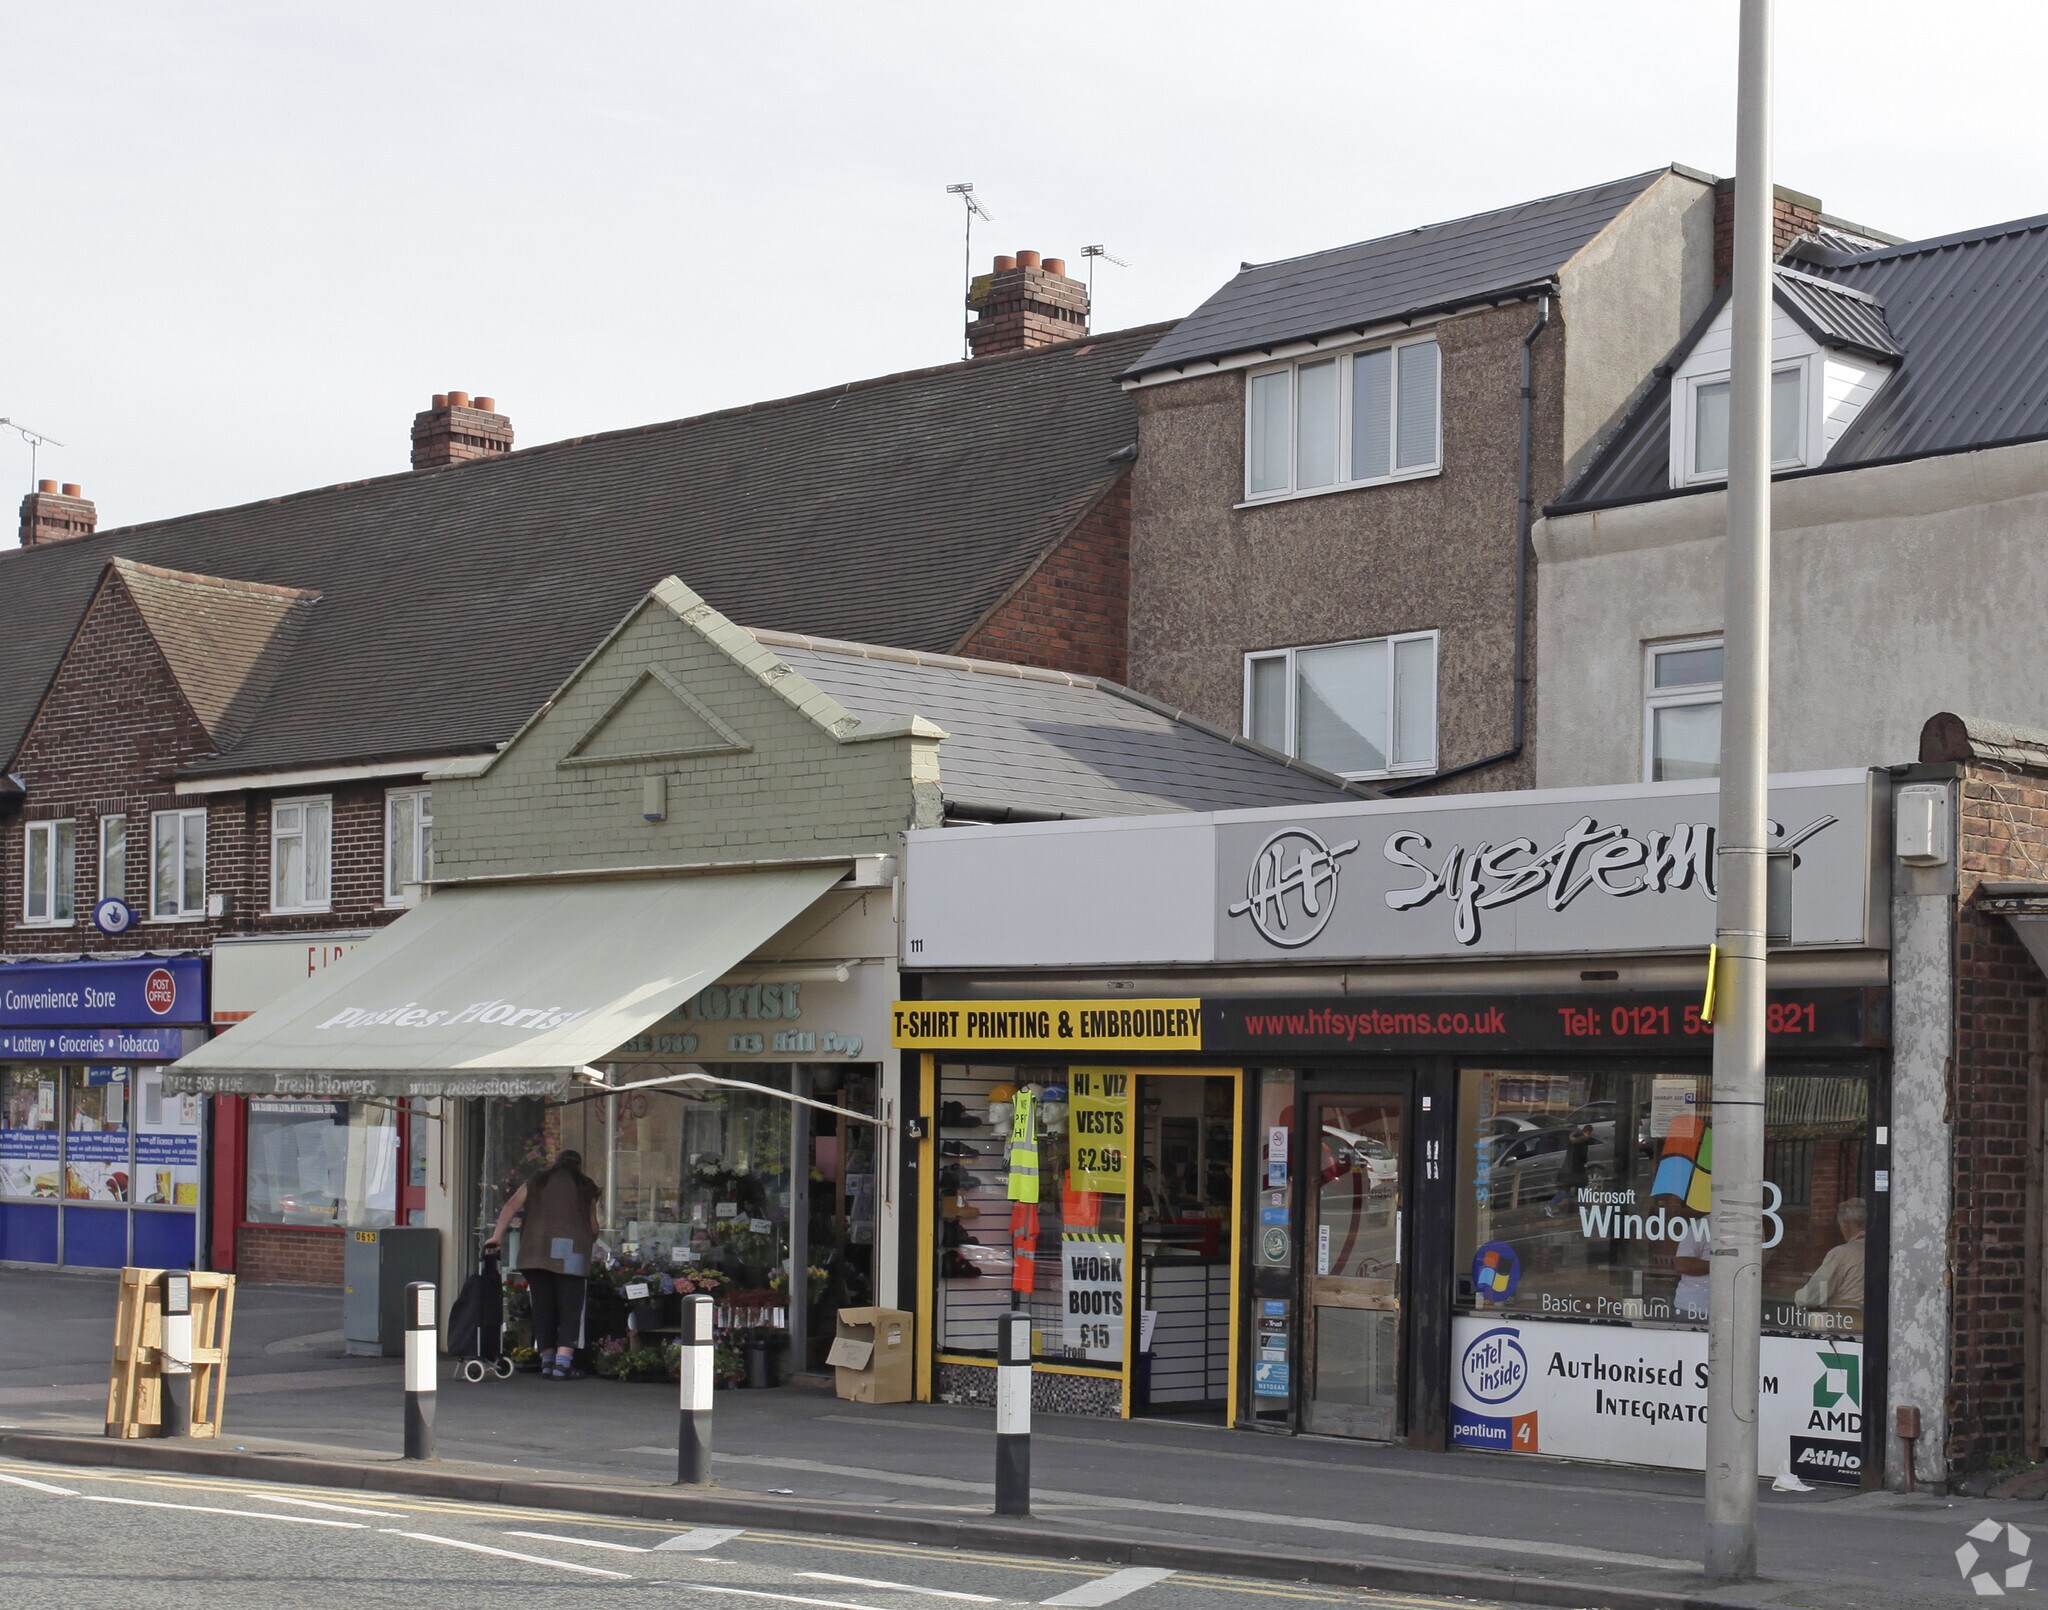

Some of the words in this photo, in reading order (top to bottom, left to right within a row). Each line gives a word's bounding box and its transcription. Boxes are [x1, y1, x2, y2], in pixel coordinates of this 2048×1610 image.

[1383, 814, 1839, 945] System
[910, 939, 923, 952] 111
[149, 991, 172, 1002] OFFICE
[153, 979, 169, 990] POST
[6, 989, 78, 1010] Convenience
[85, 987, 116, 1008] Store
[315, 1002, 449, 1029] Posies
[440, 999, 592, 1029] Florist
[894, 1011, 959, 1038] T-SHIRT
[967, 1011, 1050, 1039] PRINTING
[1058, 1010, 1074, 1038] &
[1081, 1008, 1200, 1038] EMBROIDERY
[1245, 1006, 1506, 1041] www.hfsystems.co.uk
[1558, 1008, 1600, 1036] Tel:
[1611, 1006, 1670, 1036] 0121
[1766, 1003, 1815, 1033] 821
[13, 1036, 46, 1055] Lottery
[58, 1035, 104, 1052] Groceries
[118, 1034, 159, 1052] Tobacco
[772, 1028, 816, 1053] Hill
[820, 1031, 863, 1058] Top
[274, 1073, 314, 1093] Fresh
[318, 1073, 377, 1095] Flowers
[1074, 1074, 1089, 1097] HI
[1102, 1073, 1127, 1097] VIZ
[1076, 1110, 1124, 1135] VESTS
[1077, 1148, 1122, 1173] £2.99
[1578, 1187, 1636, 1205] Microsoft
[355, 1231, 376, 1242] 0613
[1579, 1205, 1711, 1243] Window
[1071, 1257, 1122, 1282] WORK
[1069, 1290, 1123, 1315] BOOTS
[1542, 1293, 1581, 1314] Basic
[1597, 1296, 1670, 1319] Premium
[1776, 1306, 1854, 1329] Ultimate
[1080, 1324, 1110, 1349] £15
[1471, 1339, 1502, 1374] intel
[1480, 1361, 1521, 1392] inside
[1453, 1423, 1506, 1440] pentium
[1517, 1422, 1530, 1443] 4
[1807, 1409, 1861, 1434] AMD
[1796, 1447, 1860, 1468] Athlo
